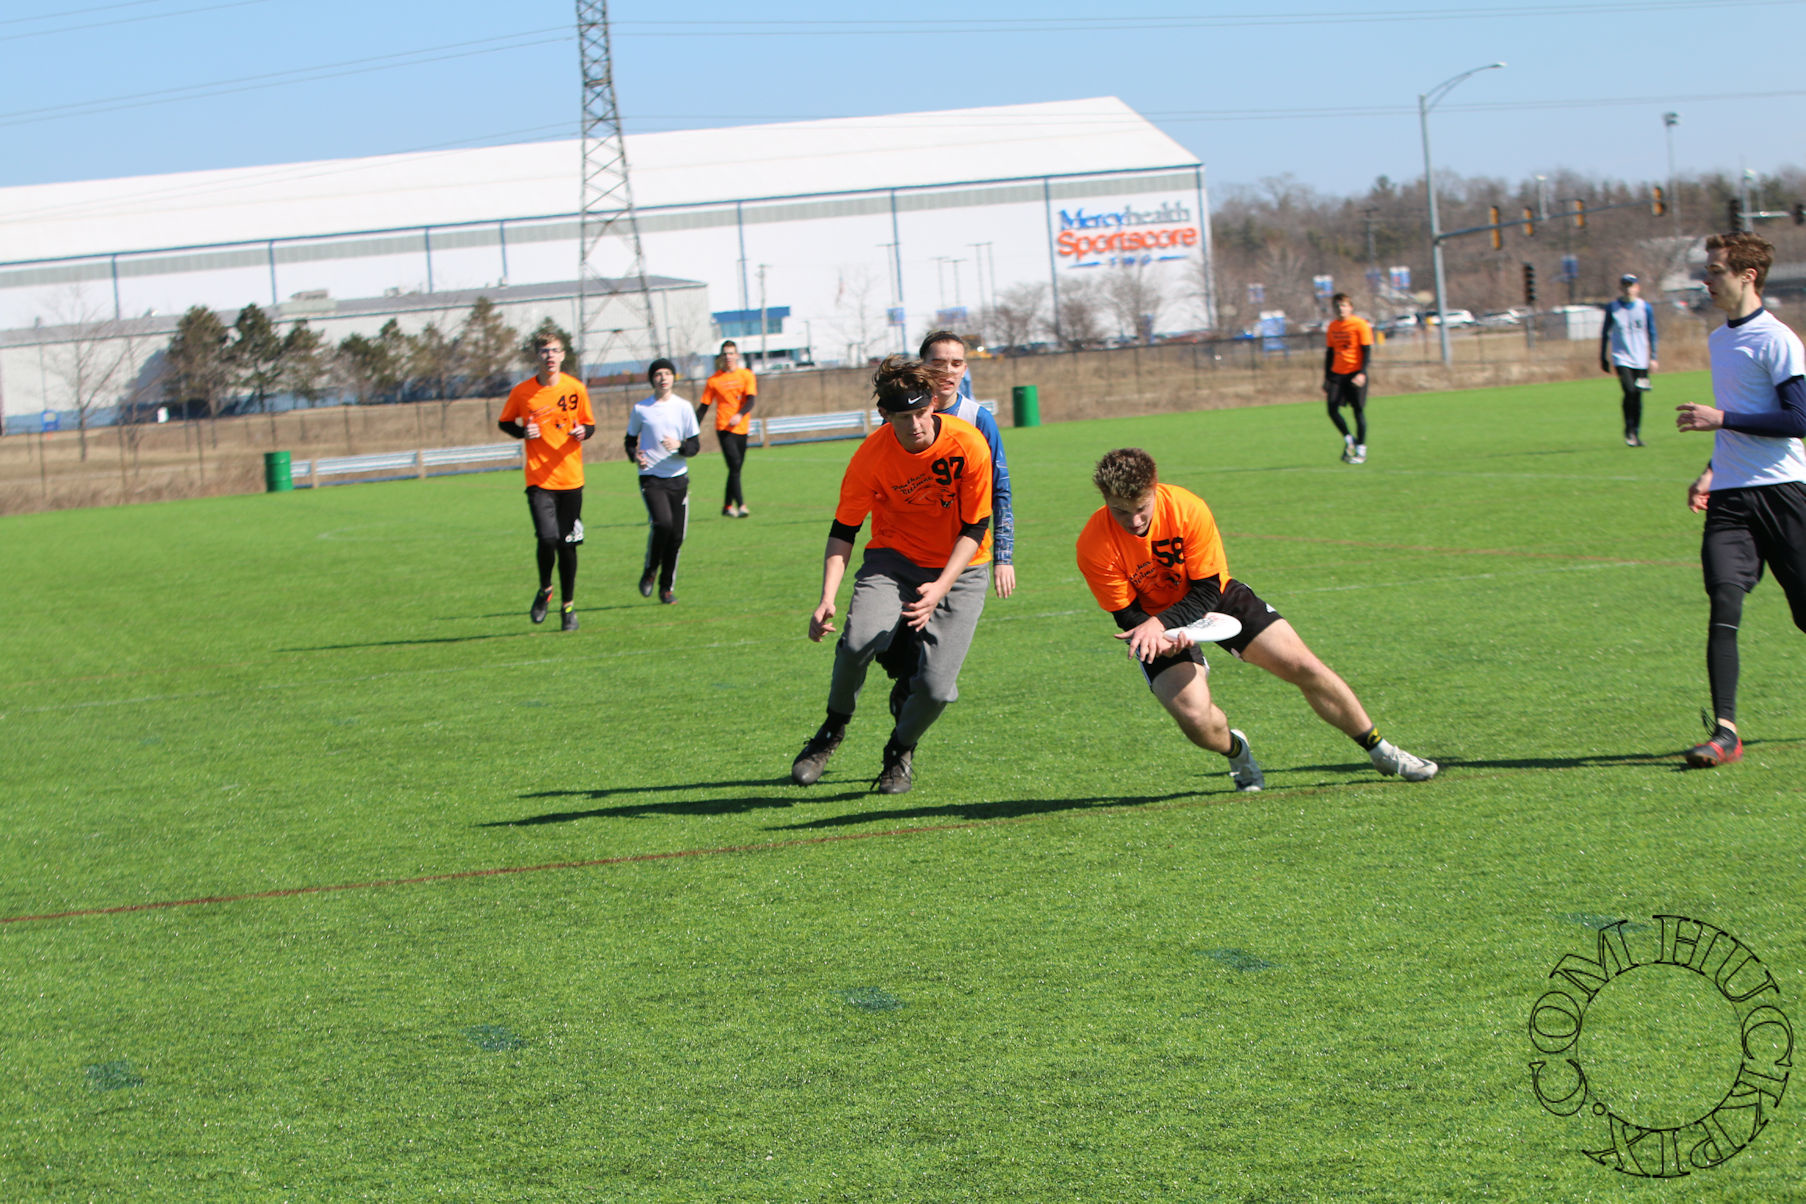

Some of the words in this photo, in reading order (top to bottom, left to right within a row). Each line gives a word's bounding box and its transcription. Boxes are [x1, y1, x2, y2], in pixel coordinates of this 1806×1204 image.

[1059, 200, 1190, 231] Mercyhealth
[1057, 227, 1197, 260] Sportscore
[557, 394, 579, 411] 49
[931, 456, 965, 485] 97
[1151, 536, 1186, 568] 58
